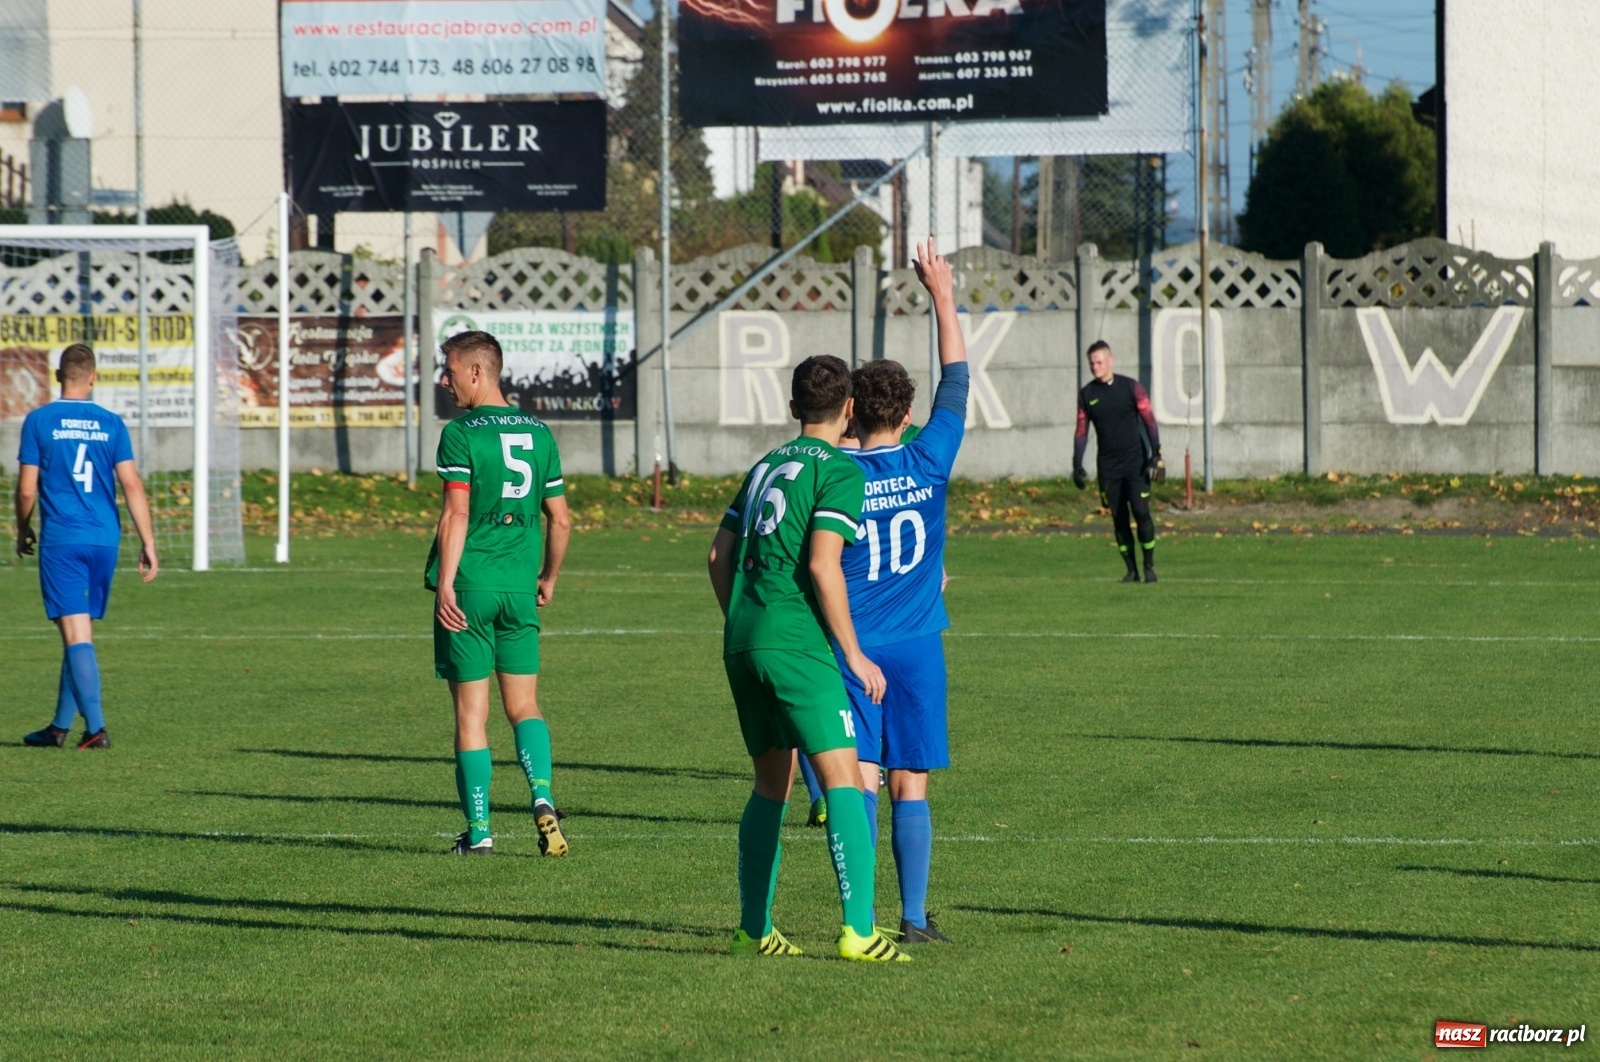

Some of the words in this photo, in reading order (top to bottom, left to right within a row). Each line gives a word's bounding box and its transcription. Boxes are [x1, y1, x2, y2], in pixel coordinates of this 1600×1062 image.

[293, 16, 598, 40] www.restauracjabravo.com.pl
[293, 60, 322, 77] tel.
[328, 60, 361, 77] 602
[368, 59, 400, 75] 744
[452, 58, 474, 75] 48
[481, 58, 514, 75] 606
[520, 57, 541, 74] 27
[547, 57, 570, 74] 08
[575, 56, 597, 73] 98
[809, 57, 834, 69] 603
[837, 56, 861, 68] 798
[863, 55, 887, 67] 977
[954, 52, 979, 63] 603
[982, 50, 1006, 62] 798
[1008, 49, 1032, 61] 967
[956, 68, 981, 79] 607
[983, 66, 1007, 78] 336
[1010, 65, 1033, 77] 321
[816, 94, 974, 114] www.fiolka.com.pl
[486, 322, 523, 335] JEDEN
[528, 322, 543, 335] ZA
[500, 339, 544, 352] SZYSCY
[549, 339, 564, 352] ZA
[72, 443, 93, 493] 4
[499, 432, 534, 499] 5
[864, 475, 917, 496] ORTECA
[742, 461, 805, 538] 16
[861, 485, 933, 513] IERKLANY
[855, 509, 926, 581] 10
[472, 785, 488, 832] TWORKW
